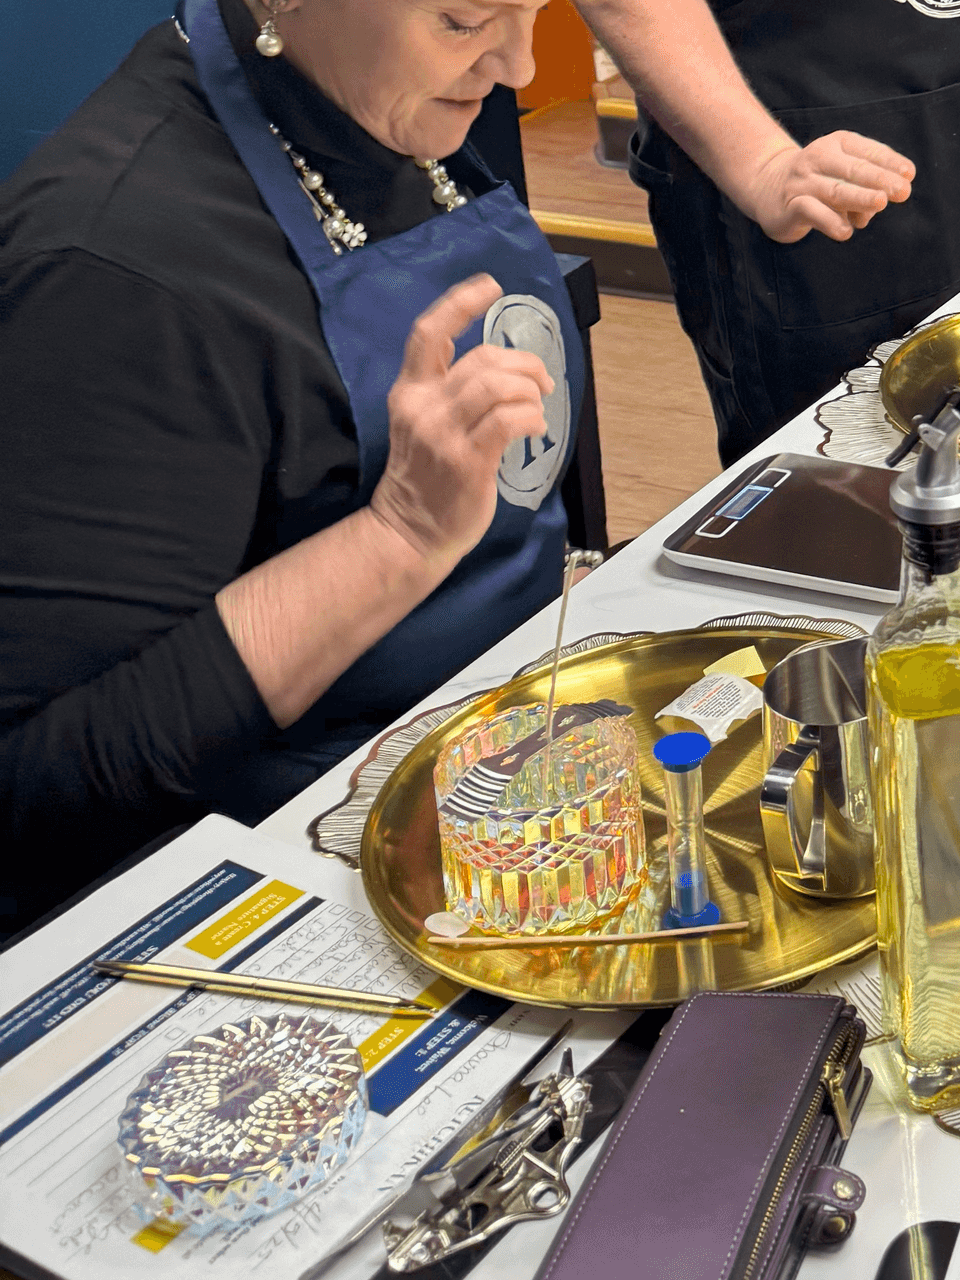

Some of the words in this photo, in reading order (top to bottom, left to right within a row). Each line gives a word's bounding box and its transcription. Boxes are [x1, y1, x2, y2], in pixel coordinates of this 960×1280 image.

[235, 893, 277, 921] Signature
[259, 895, 286, 913] STEP
[210, 921, 238, 940] Name
[221, 921, 251, 940] Create
[445, 1013, 487, 1045] Welcome,
[447, 1019, 460, 1028] &
[376, 1027, 404, 1047] STEP
[424, 1027, 452, 1048] STEP
[414, 1045, 451, 1072] Waiver,
